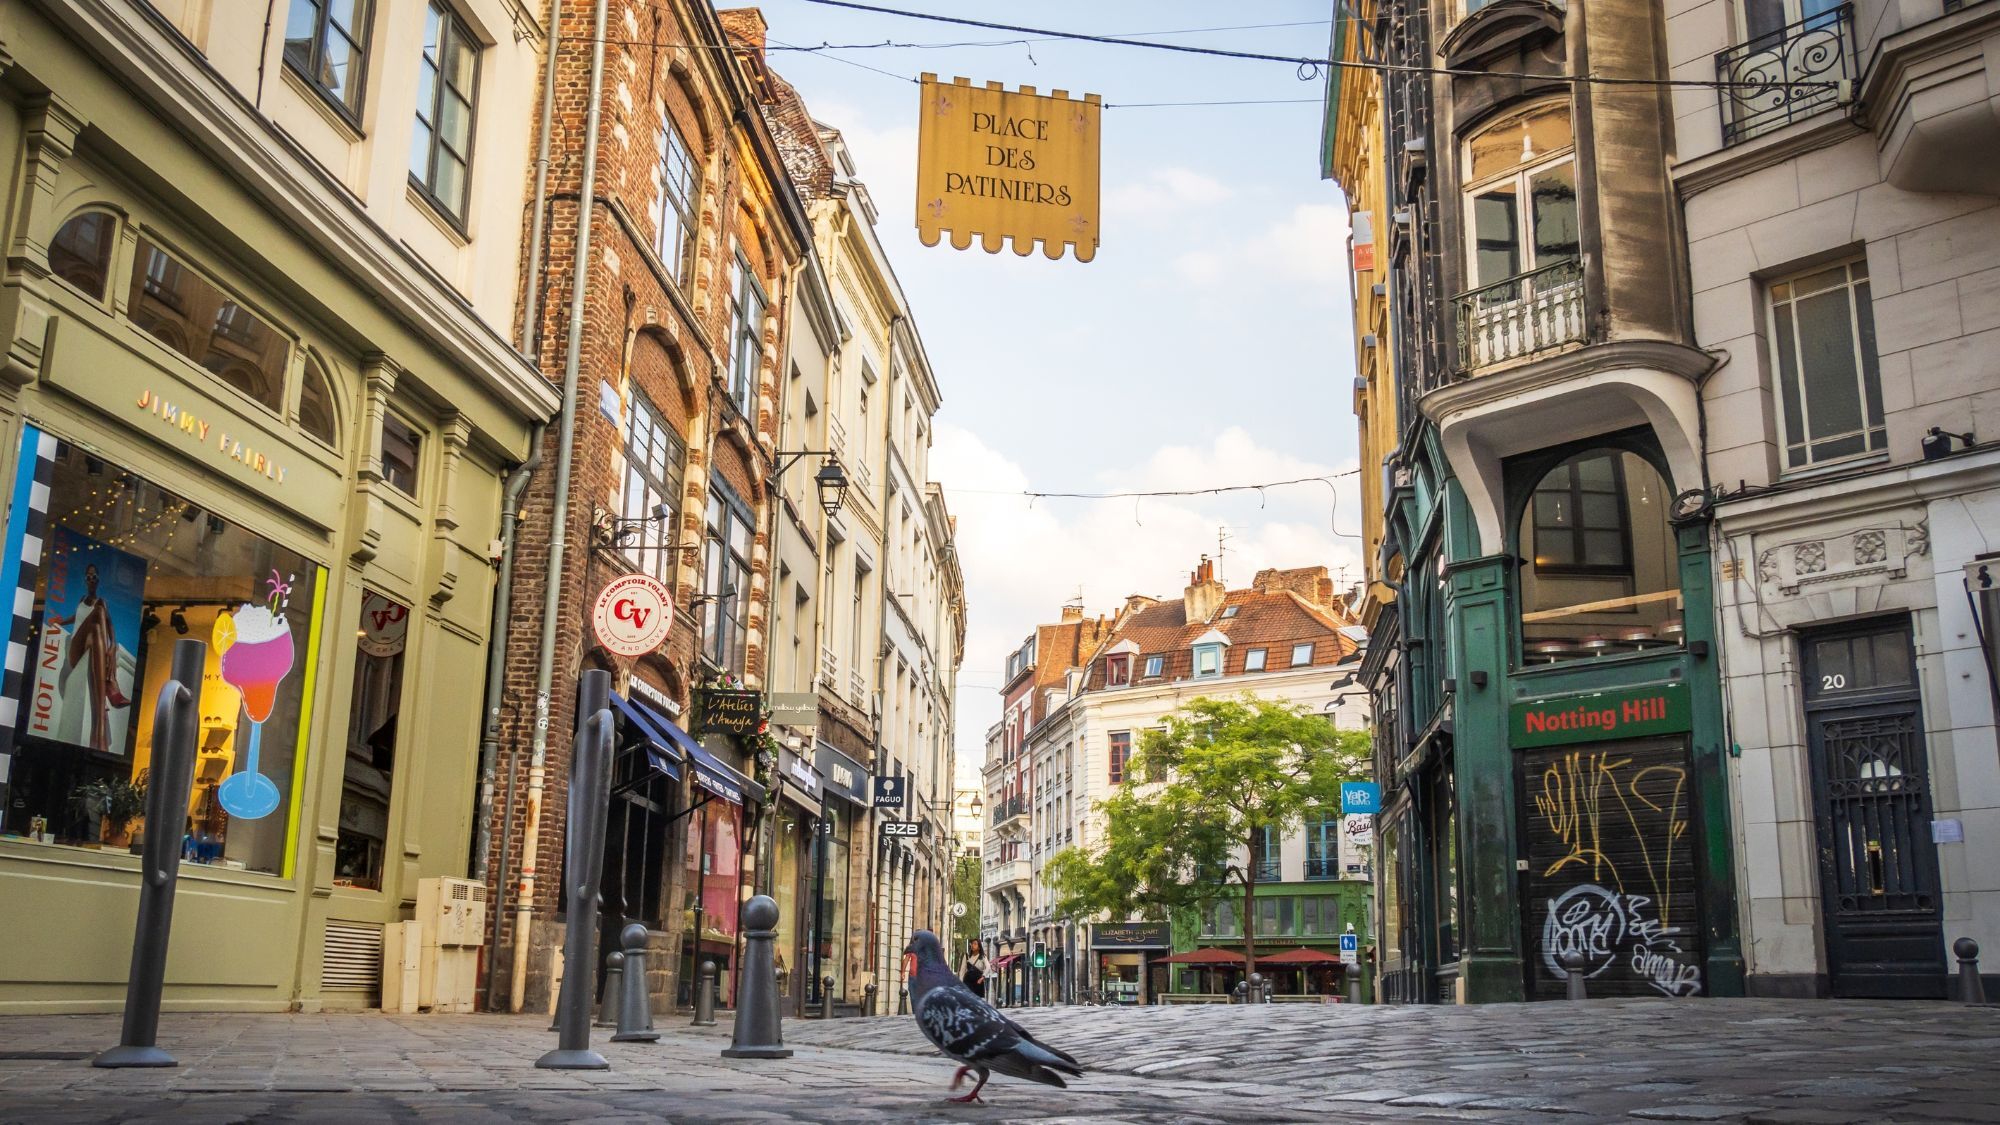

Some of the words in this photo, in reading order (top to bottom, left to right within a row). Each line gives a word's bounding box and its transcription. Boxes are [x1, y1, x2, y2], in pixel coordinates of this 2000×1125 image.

[973, 112, 1048, 141] PLACE
[986, 145, 1035, 171] DES
[945, 172, 1072, 207] PATINIERS
[137, 389, 210, 442] JIMMY
[220, 432, 288, 484] FAIRLY
[600, 598, 607, 608] LE
[606, 579, 647, 597] COMPTOIR
[647, 581, 668, 608] VOLANT
[614, 599, 651, 629] CV
[42, 609, 64, 671] NEW
[600, 628, 617, 646] BEEF
[645, 629, 664, 647] LOVE
[1822, 674, 1845, 690] 20
[32, 677, 55, 732] HOT
[708, 697, 754, 712] L'Atelier
[1526, 706, 1616, 734] Notting
[1622, 697, 1666, 723] Hill
[707, 712, 753, 733] d'Amaya
[885, 823, 918, 835] BZB
